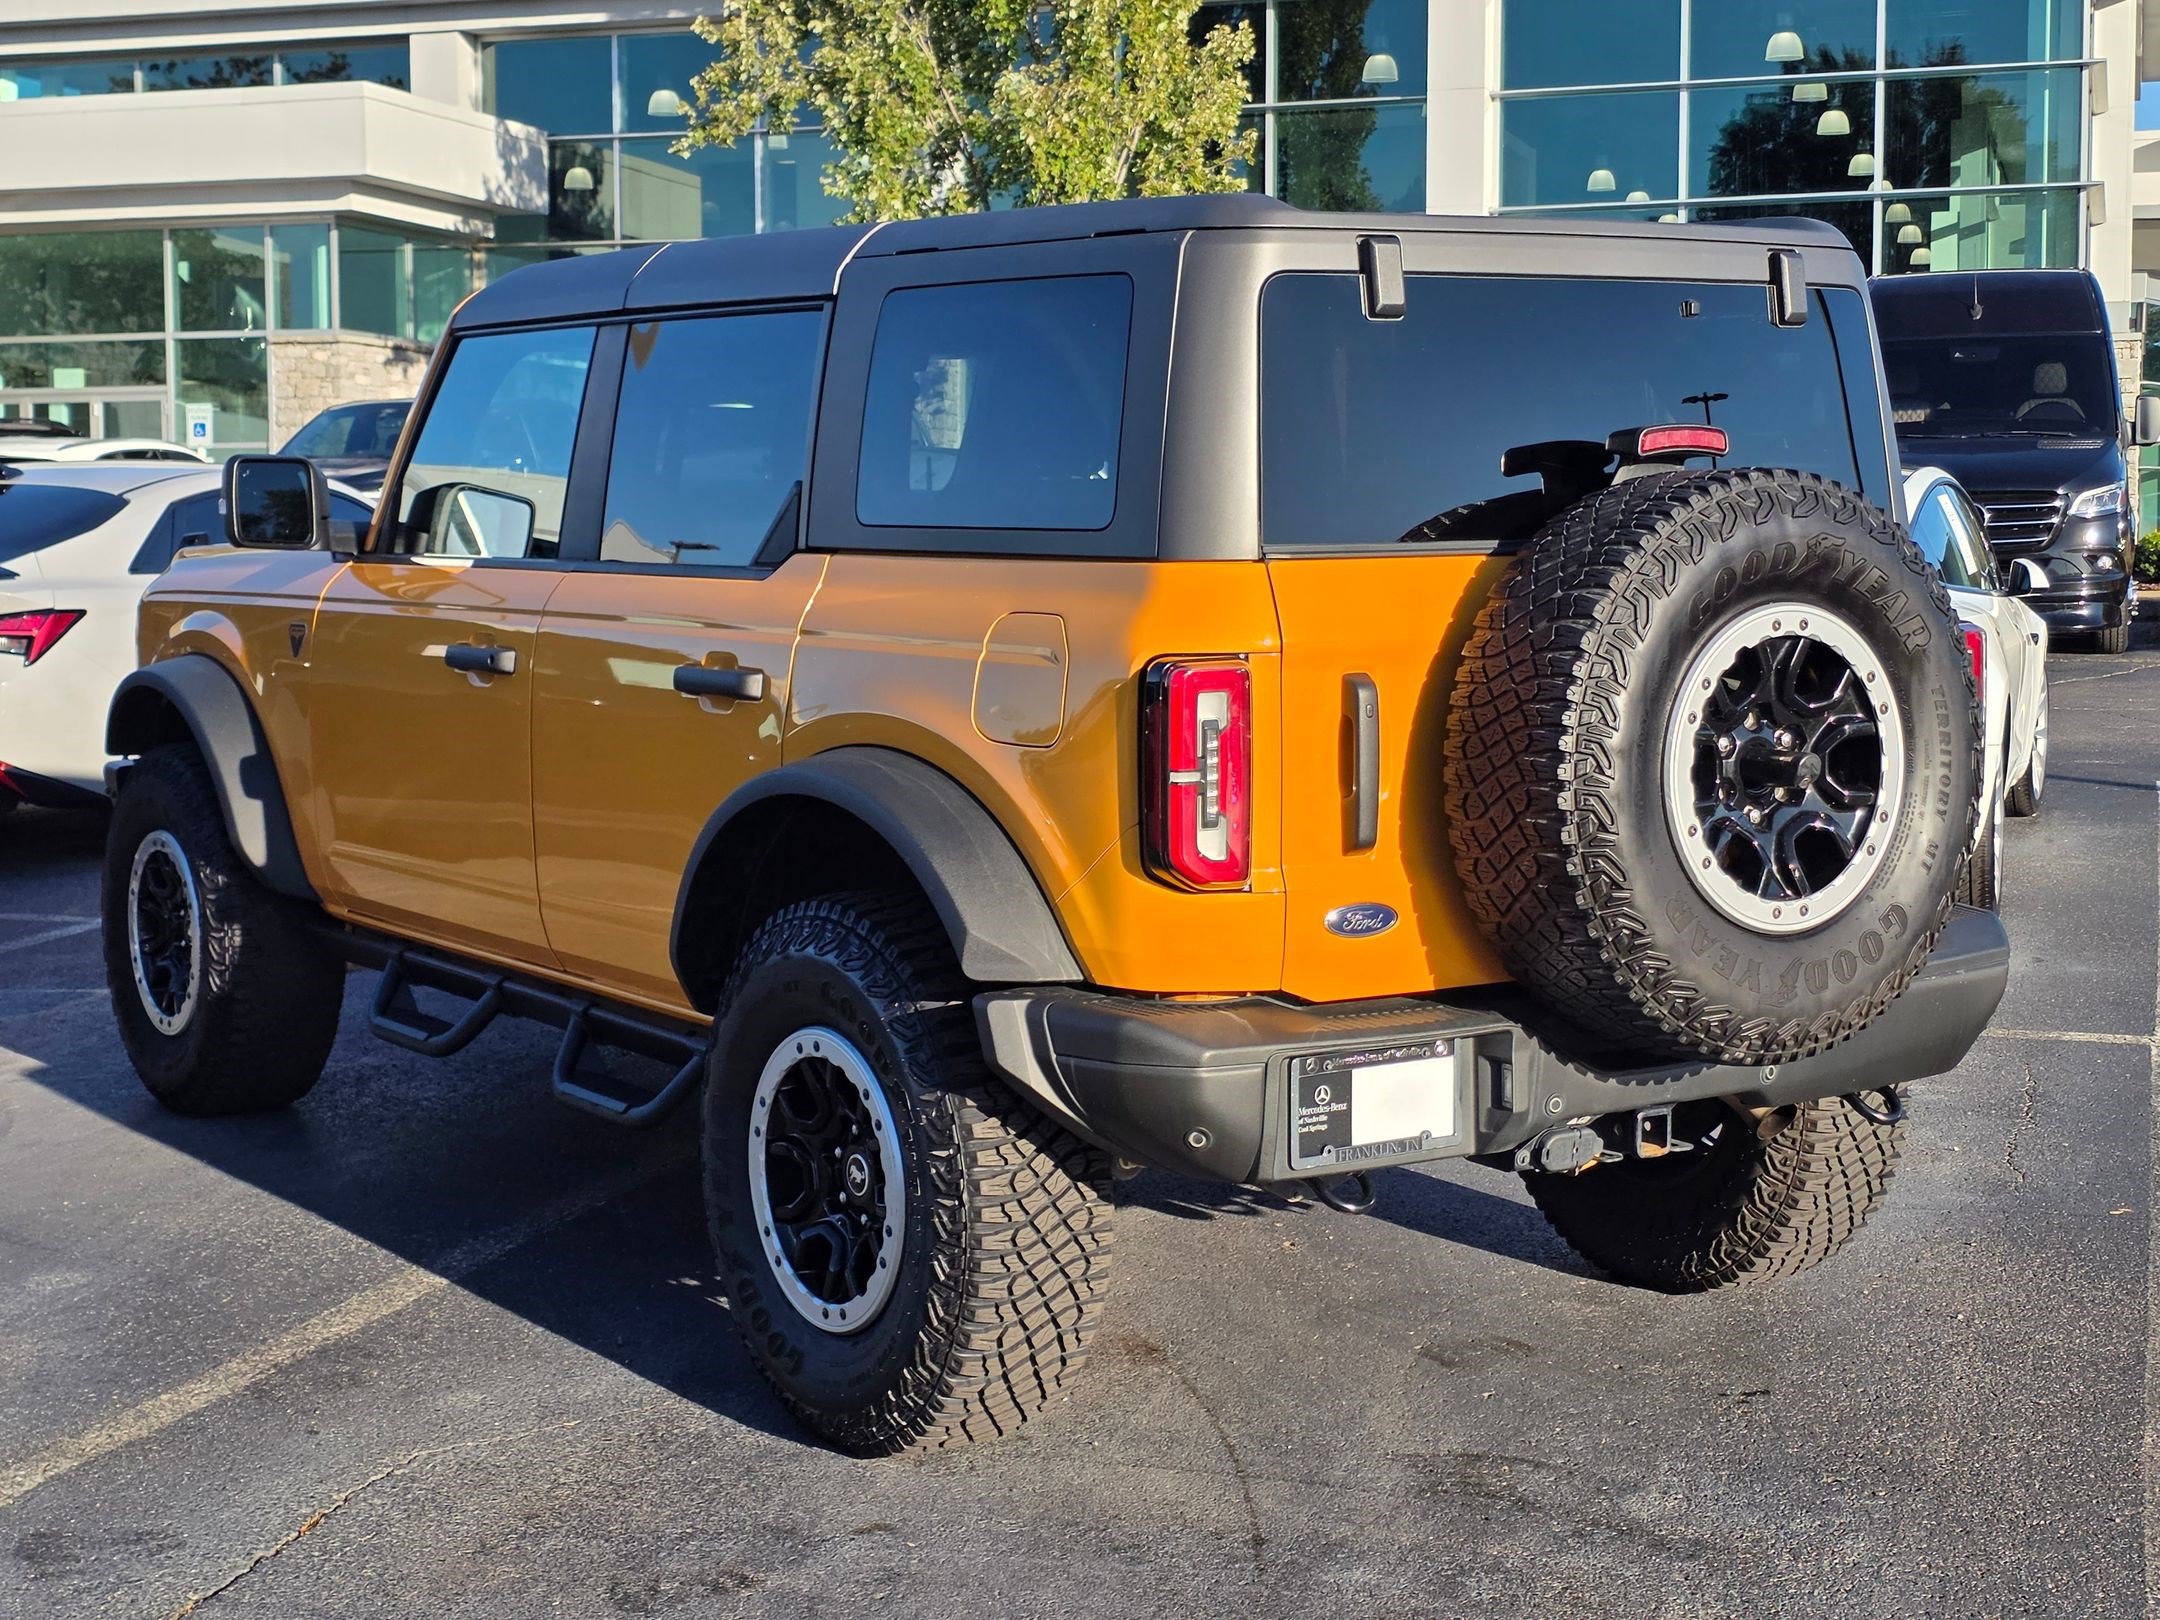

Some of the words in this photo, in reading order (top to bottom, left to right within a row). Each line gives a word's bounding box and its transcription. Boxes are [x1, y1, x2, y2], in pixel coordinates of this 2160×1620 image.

[1688, 541, 1932, 655] GOODYEAR
[1931, 684, 1952, 824] TERRITORY
[1342, 910, 1384, 932] Ford
[1298, 1102, 1348, 1116] Mercedes-Benz
[1404, 1137, 1420, 1152] TN
